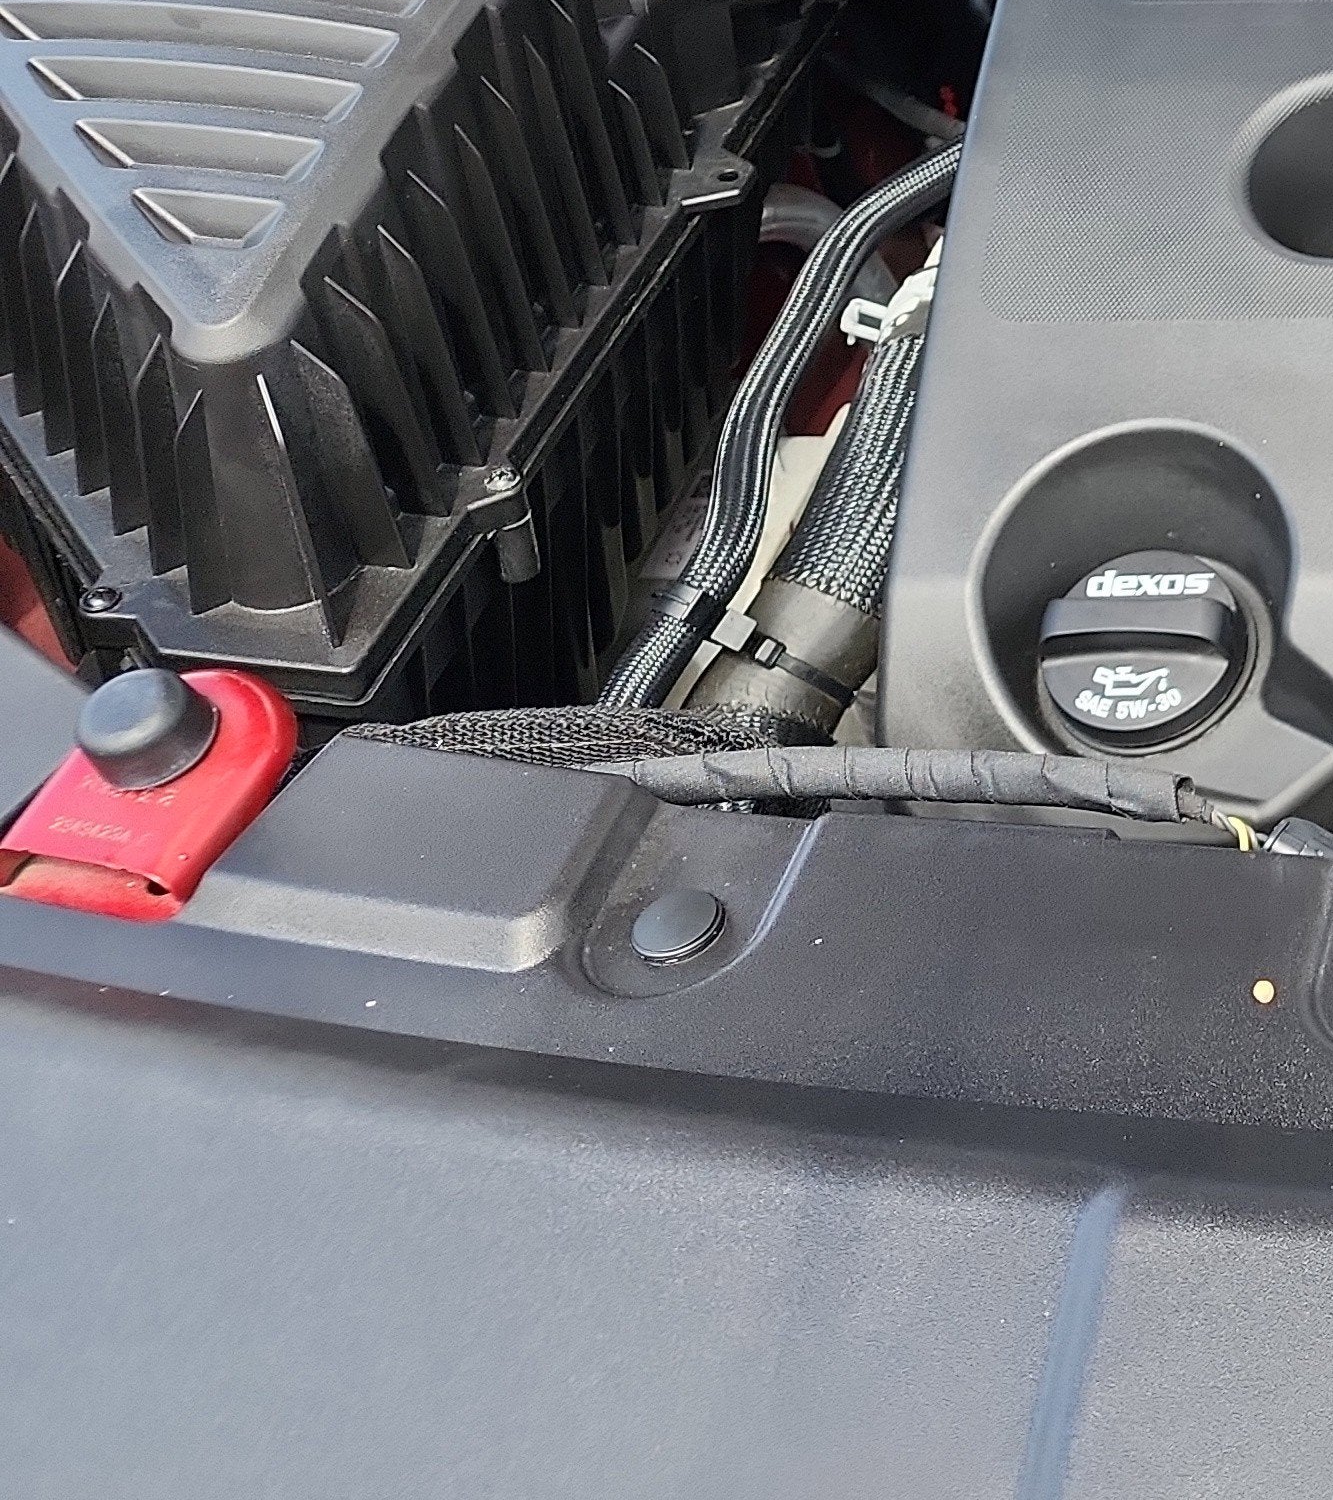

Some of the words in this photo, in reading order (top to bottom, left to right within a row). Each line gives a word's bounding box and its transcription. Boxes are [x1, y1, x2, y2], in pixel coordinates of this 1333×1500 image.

[1085, 569, 1216, 598] dexos
[1074, 689, 1115, 719] SAE
[1114, 688, 1182, 720] 5W-30
